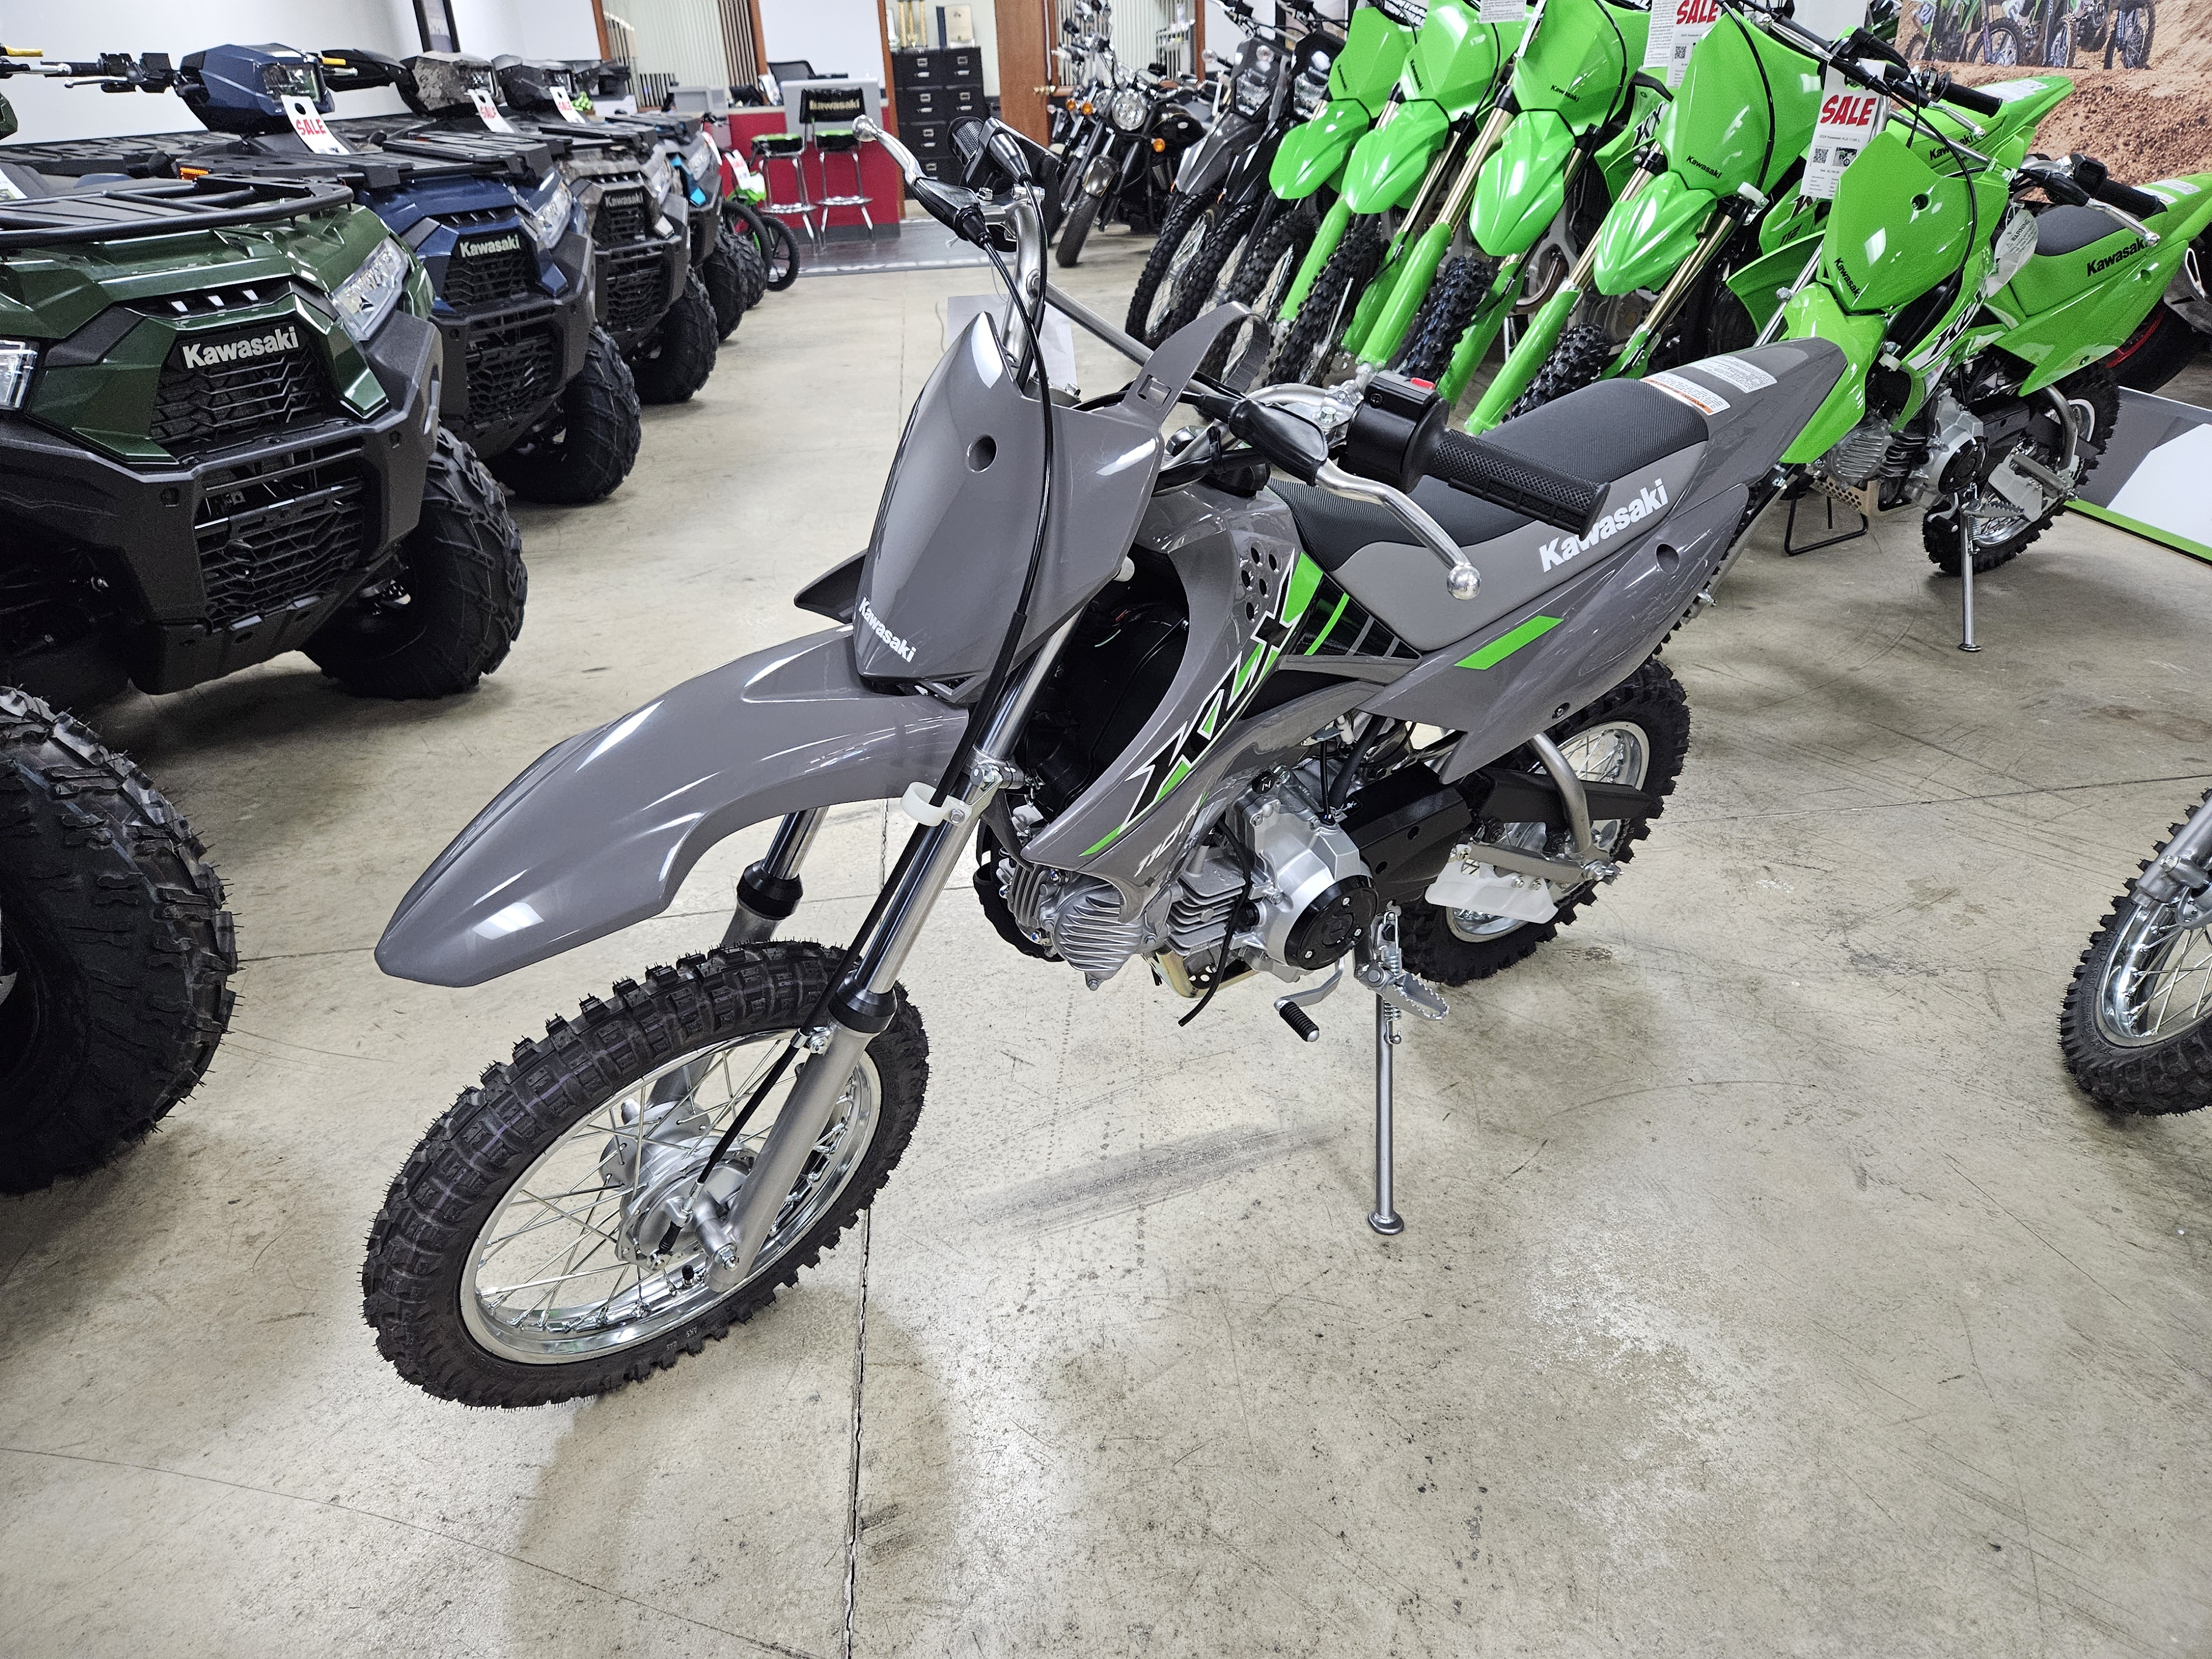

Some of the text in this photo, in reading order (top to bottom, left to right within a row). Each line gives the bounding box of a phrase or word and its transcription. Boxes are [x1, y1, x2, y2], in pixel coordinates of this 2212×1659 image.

[1676, 0, 1719, 24] SALE
[1550, 85, 1580, 103] Kawasaki
[1820, 95, 1876, 127] SALE
[296, 118, 326, 135] SALE
[1929, 133, 1973, 161] Kawaki
[1686, 155, 1723, 179] Kawasaki
[604, 191, 643, 207] Kawasaki
[2011, 219, 2030, 241] WARNING
[460, 234, 520, 258] Kawasaki
[2086, 237, 2148, 277] Kawasak
[182, 326, 299, 369] Kawasaki
[1539, 478, 1668, 572] Kawasaki
[858, 596, 917, 662] Kawasaki
